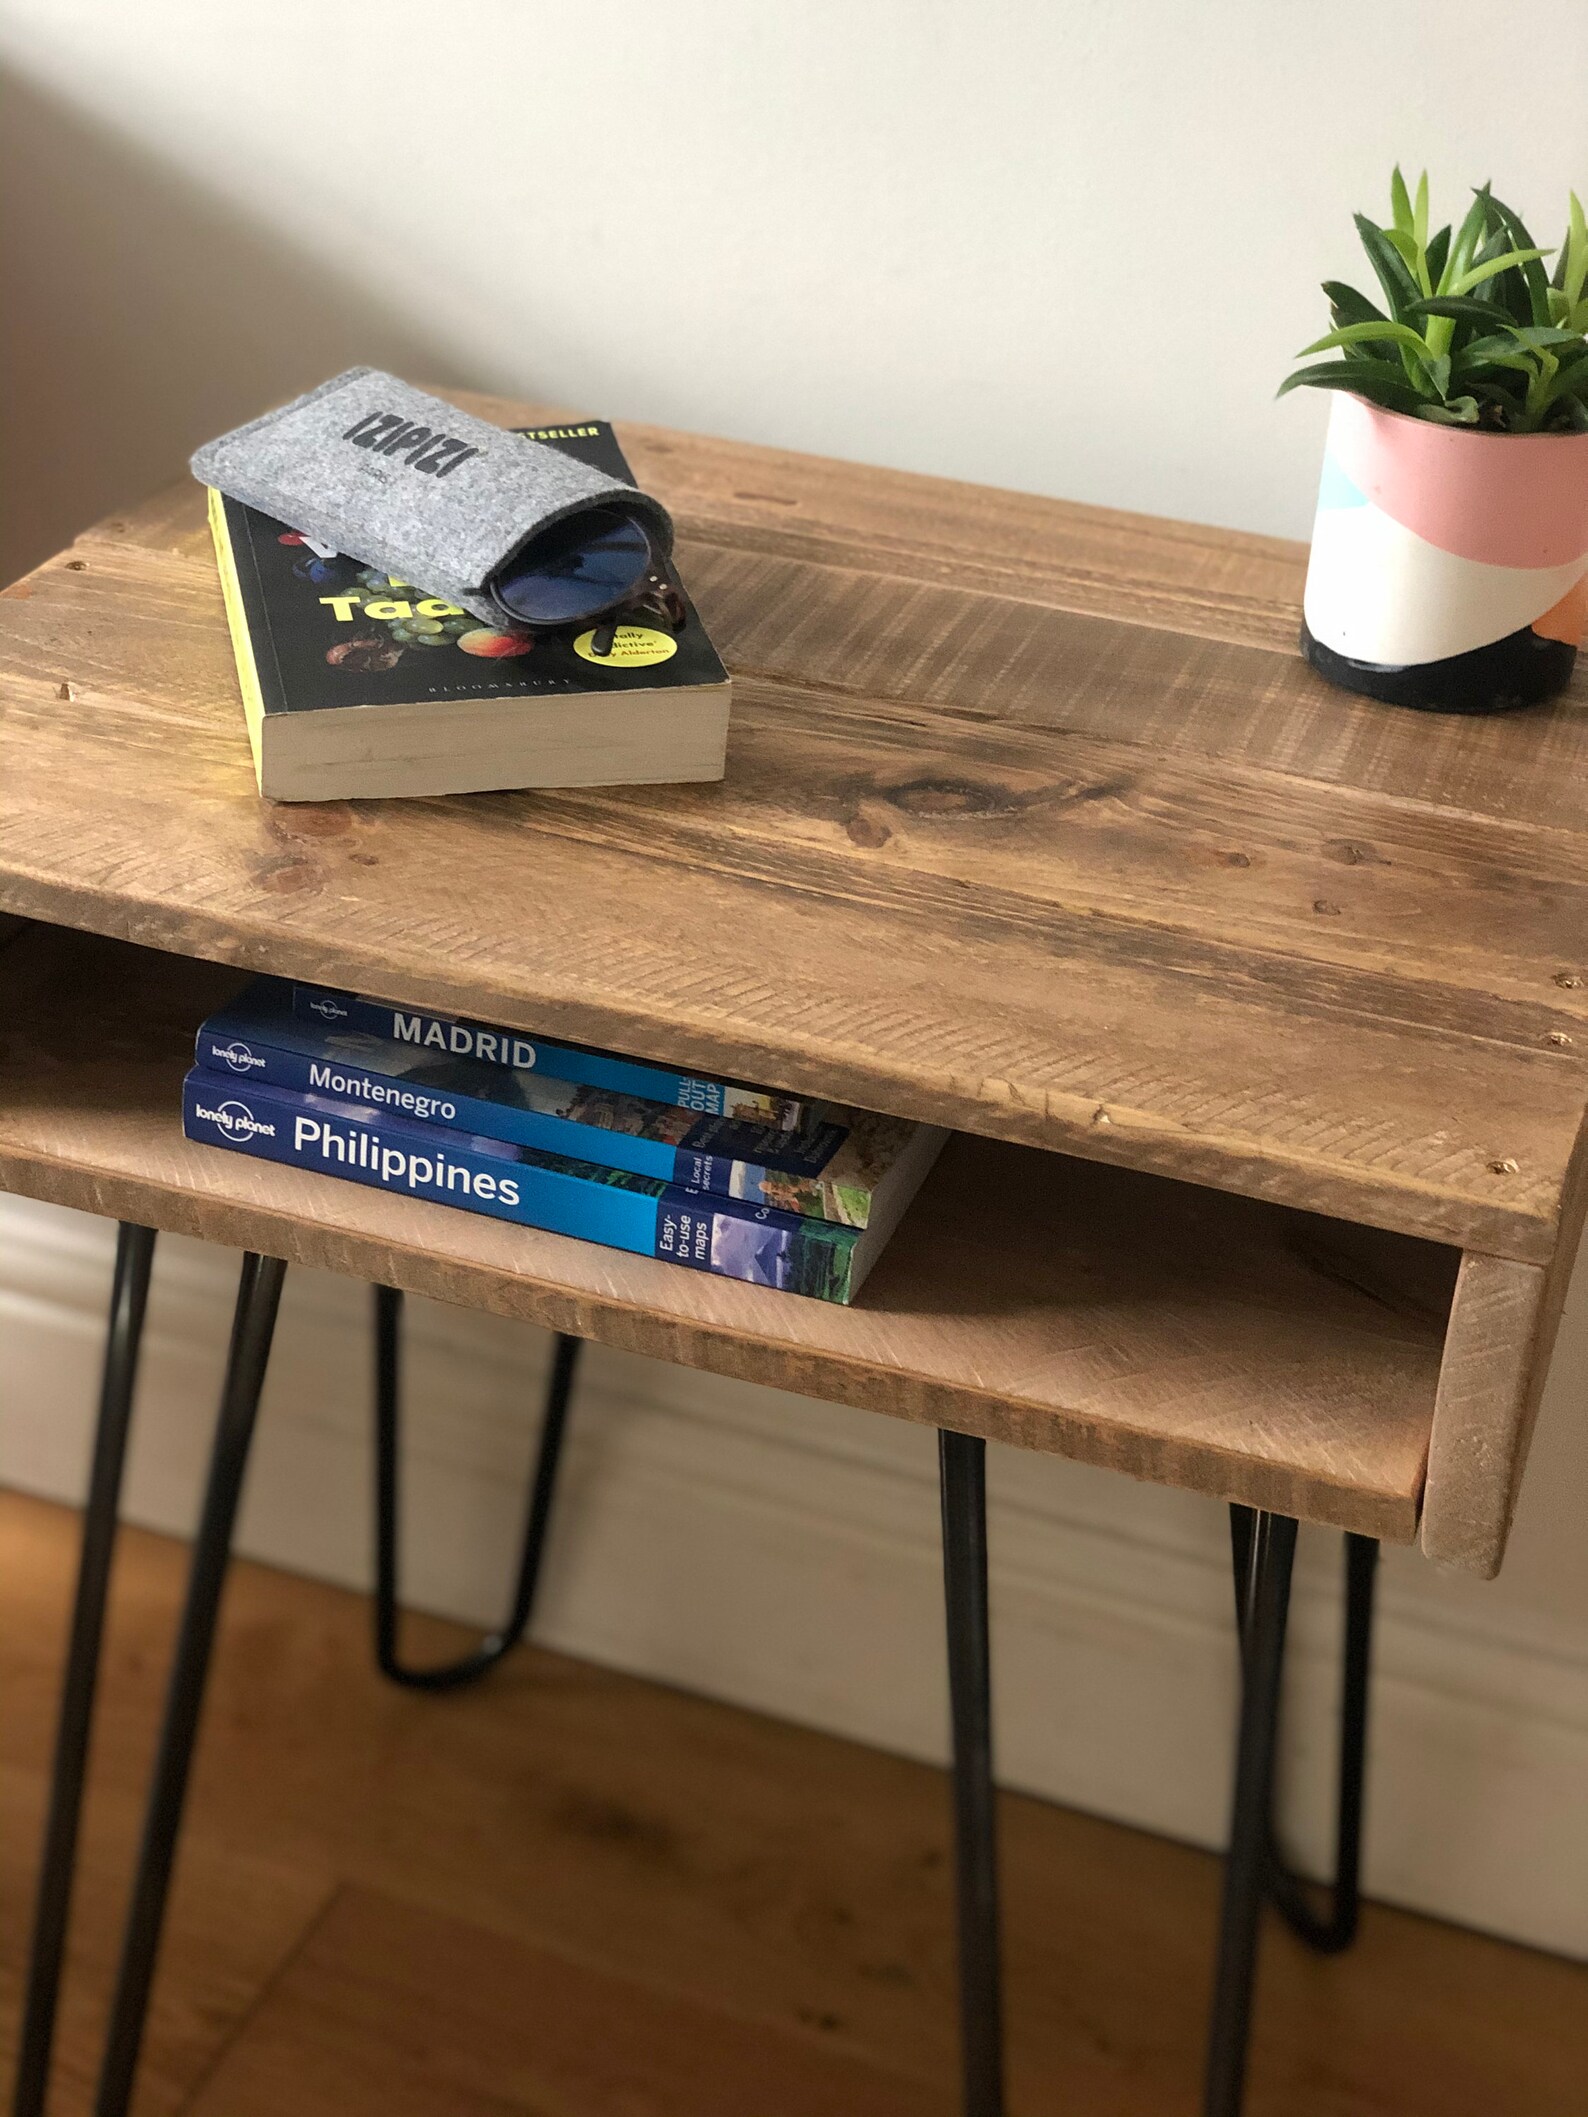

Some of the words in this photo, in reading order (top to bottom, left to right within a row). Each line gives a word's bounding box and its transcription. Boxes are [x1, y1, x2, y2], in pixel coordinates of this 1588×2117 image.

[342, 411, 479, 478] IZIPIZI
[310, 1001, 329, 1014] lonely
[328, 1007, 348, 1017] planet
[212, 1045, 238, 1063] lonely
[238, 1053, 266, 1068] planet
[393, 1012, 536, 1069] MADRID
[309, 1063, 457, 1120] Montenegro
[690, 1079, 706, 1112] OUT
[705, 1082, 721, 1116] MAP
[195, 1103, 234, 1130] lonely
[235, 1116, 276, 1137] planet
[294, 1115, 521, 1207] Philippines
[691, 1157, 702, 1184] Local
[702, 1155, 714, 1191] secrets
[659, 1214, 677, 1252] Easy-
[676, 1214, 692, 1258] to-use
[694, 1222, 710, 1260] maps
